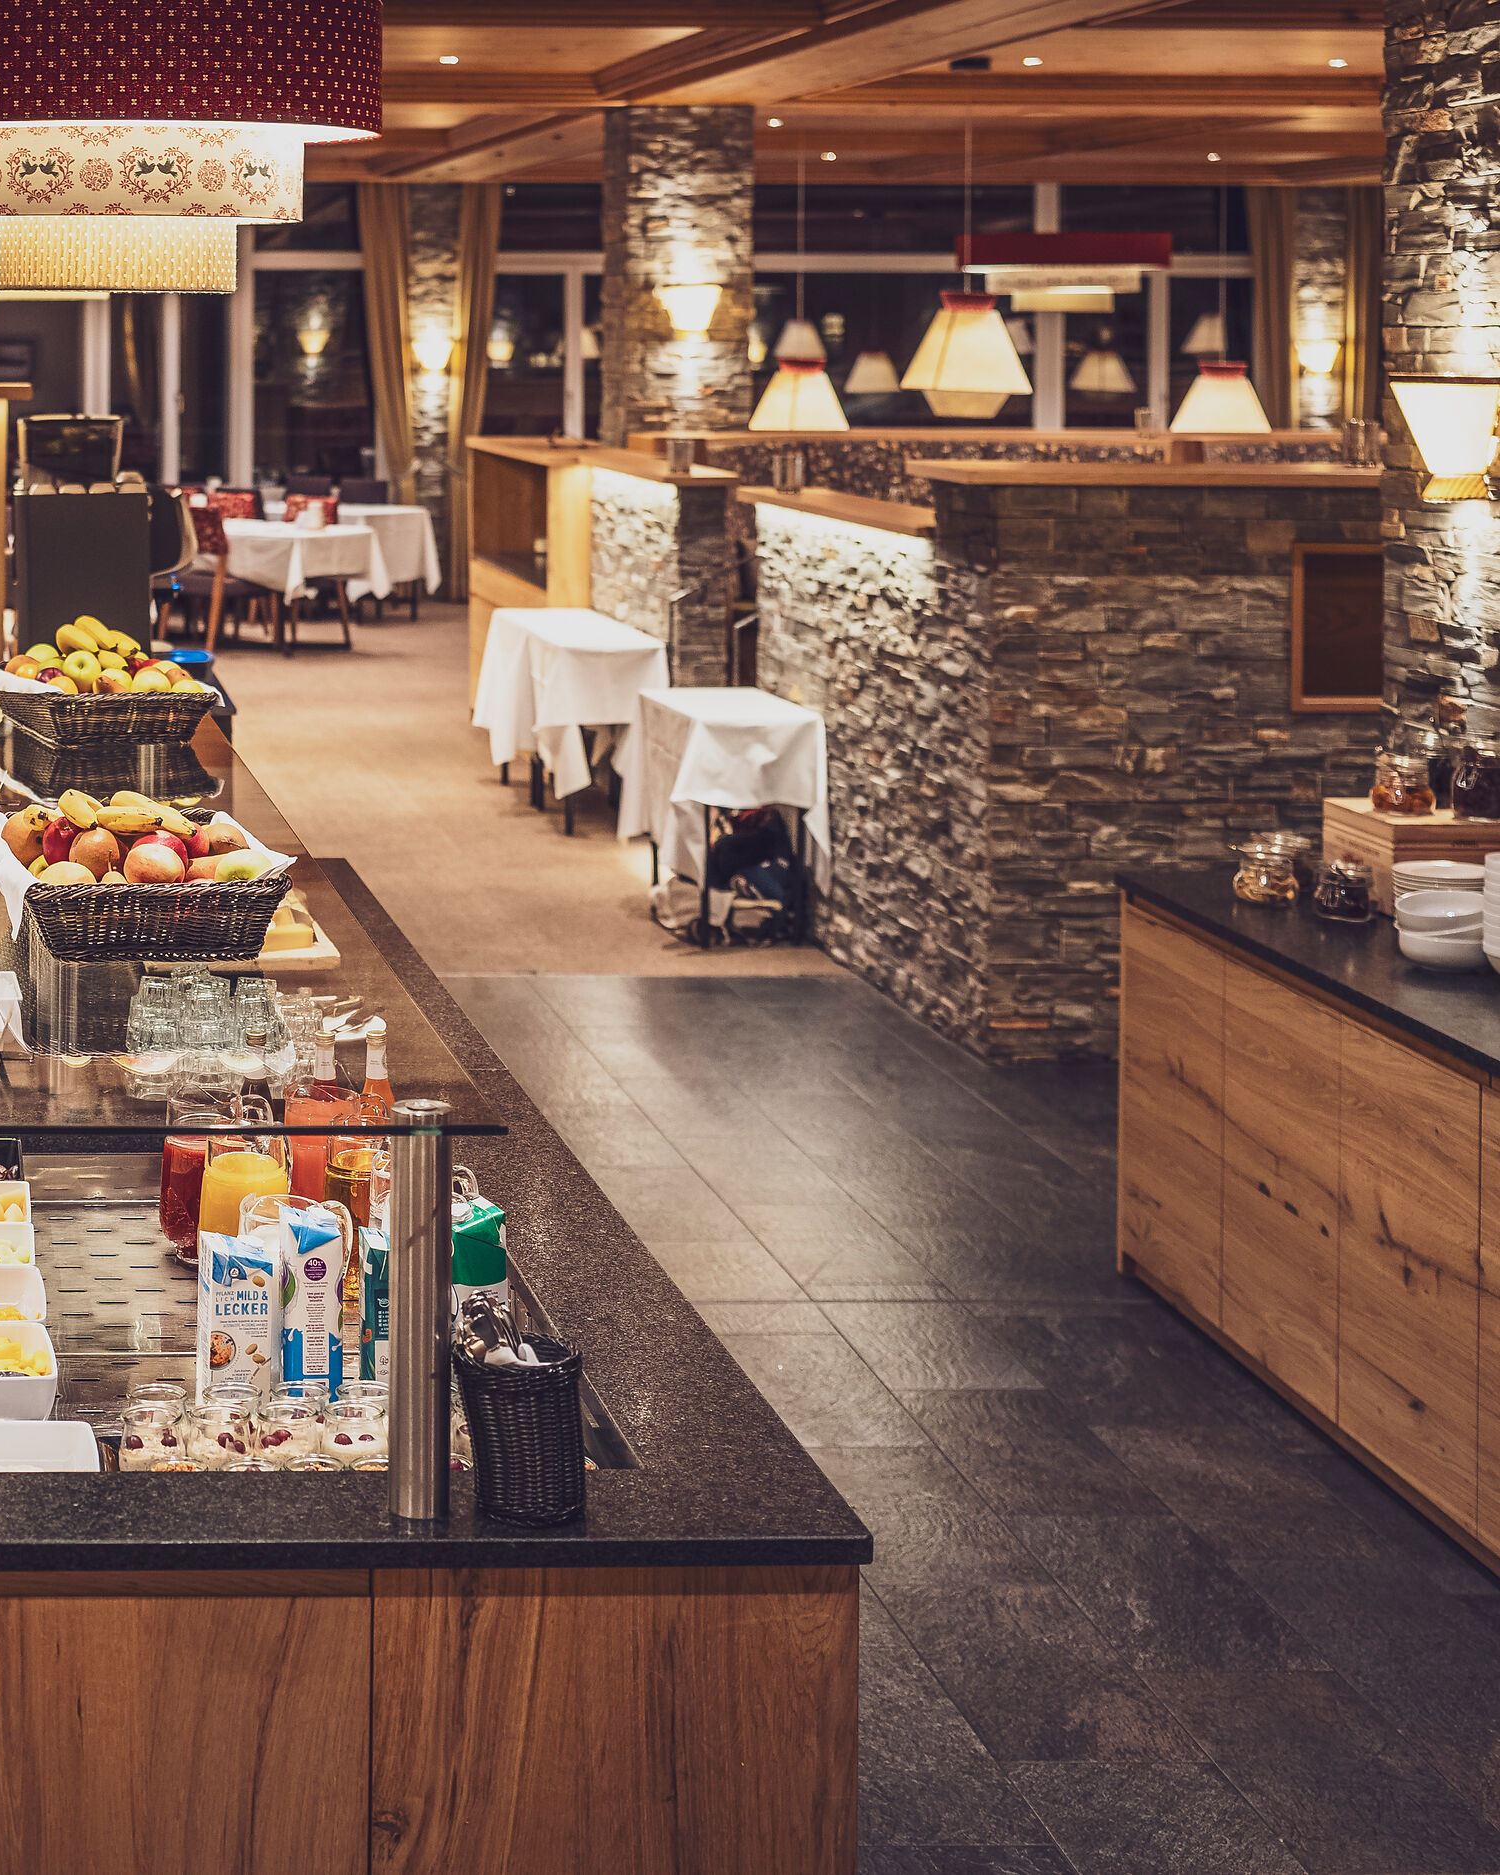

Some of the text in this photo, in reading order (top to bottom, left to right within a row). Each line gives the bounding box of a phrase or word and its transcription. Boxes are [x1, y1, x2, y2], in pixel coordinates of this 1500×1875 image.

[236, 1290, 268, 1301] MILD &
[215, 1302, 268, 1316] LECKER
